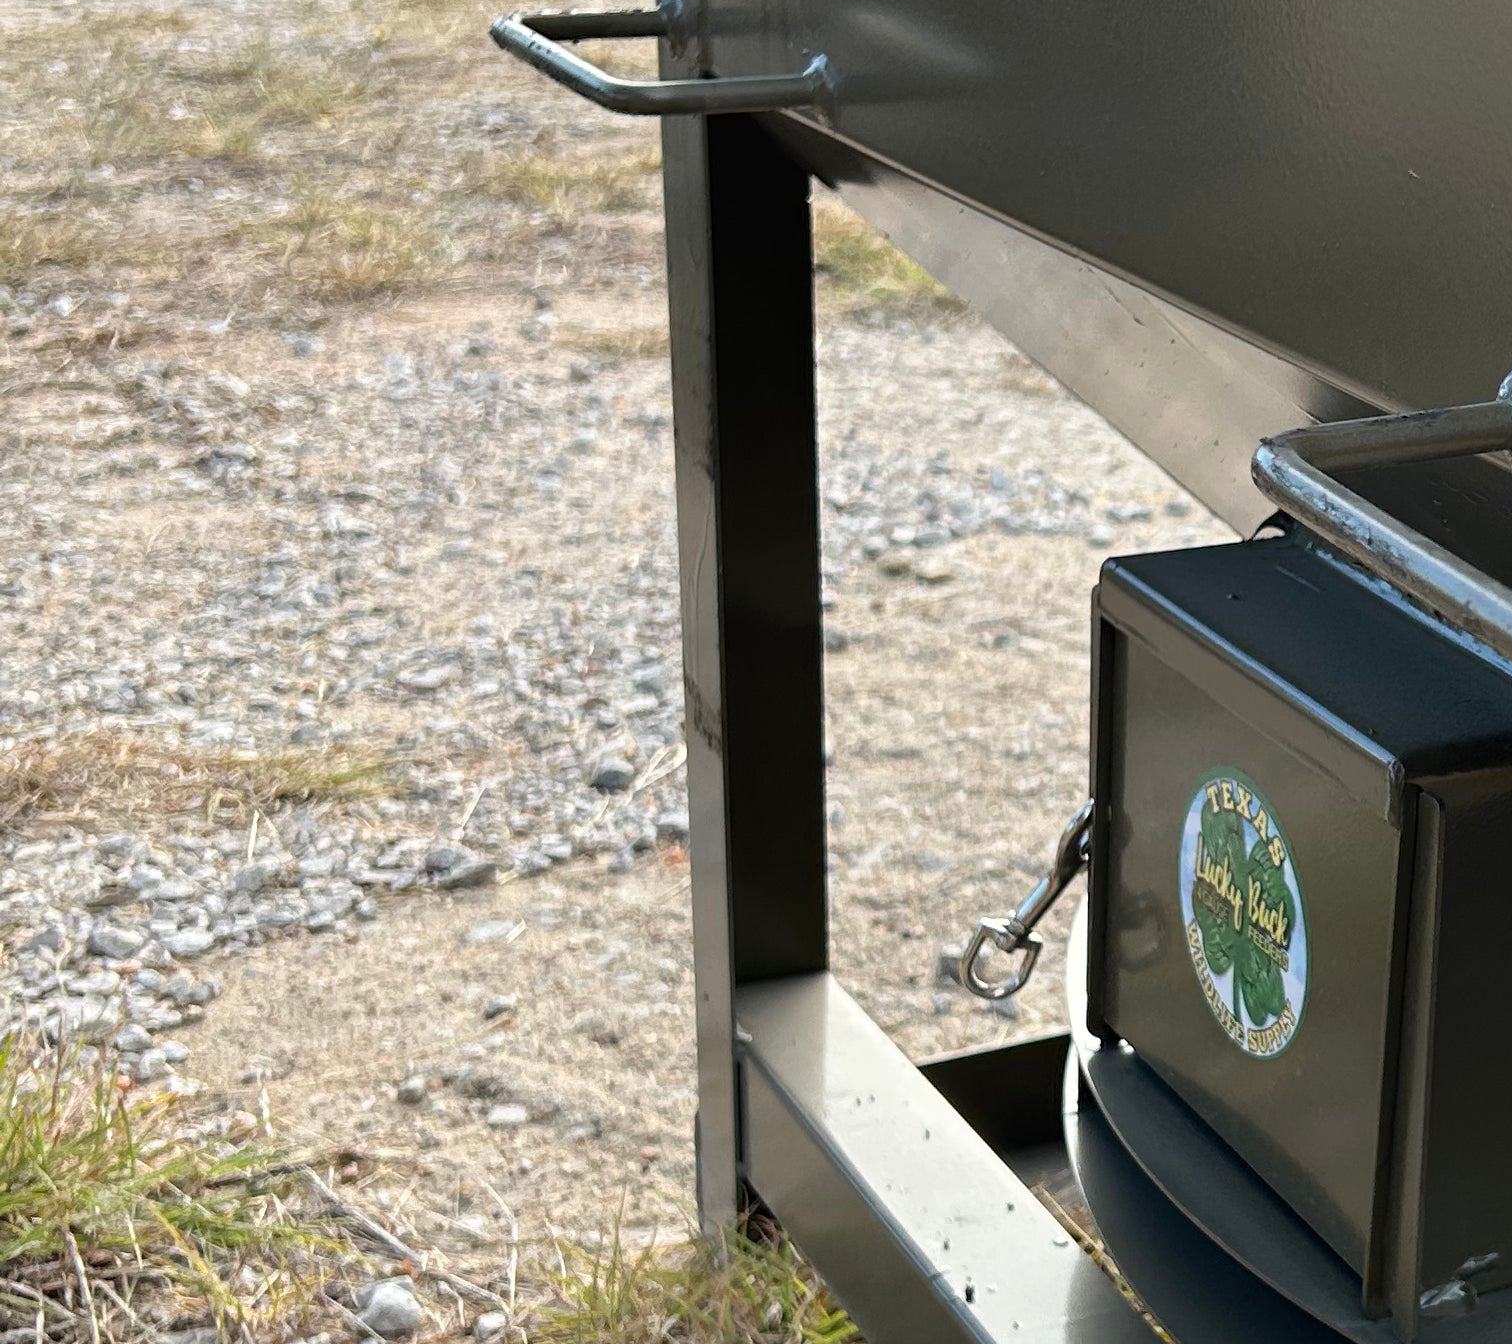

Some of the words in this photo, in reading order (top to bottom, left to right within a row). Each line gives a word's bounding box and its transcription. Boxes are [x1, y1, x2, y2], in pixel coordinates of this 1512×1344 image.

[1205, 780, 1286, 868] TEXAS
[1196, 831, 1243, 932] Lucky
[1248, 874, 1289, 949] Buck
[1187, 920, 1245, 1045] WILDLIFE
[1246, 999, 1296, 1054] SUPPLY
